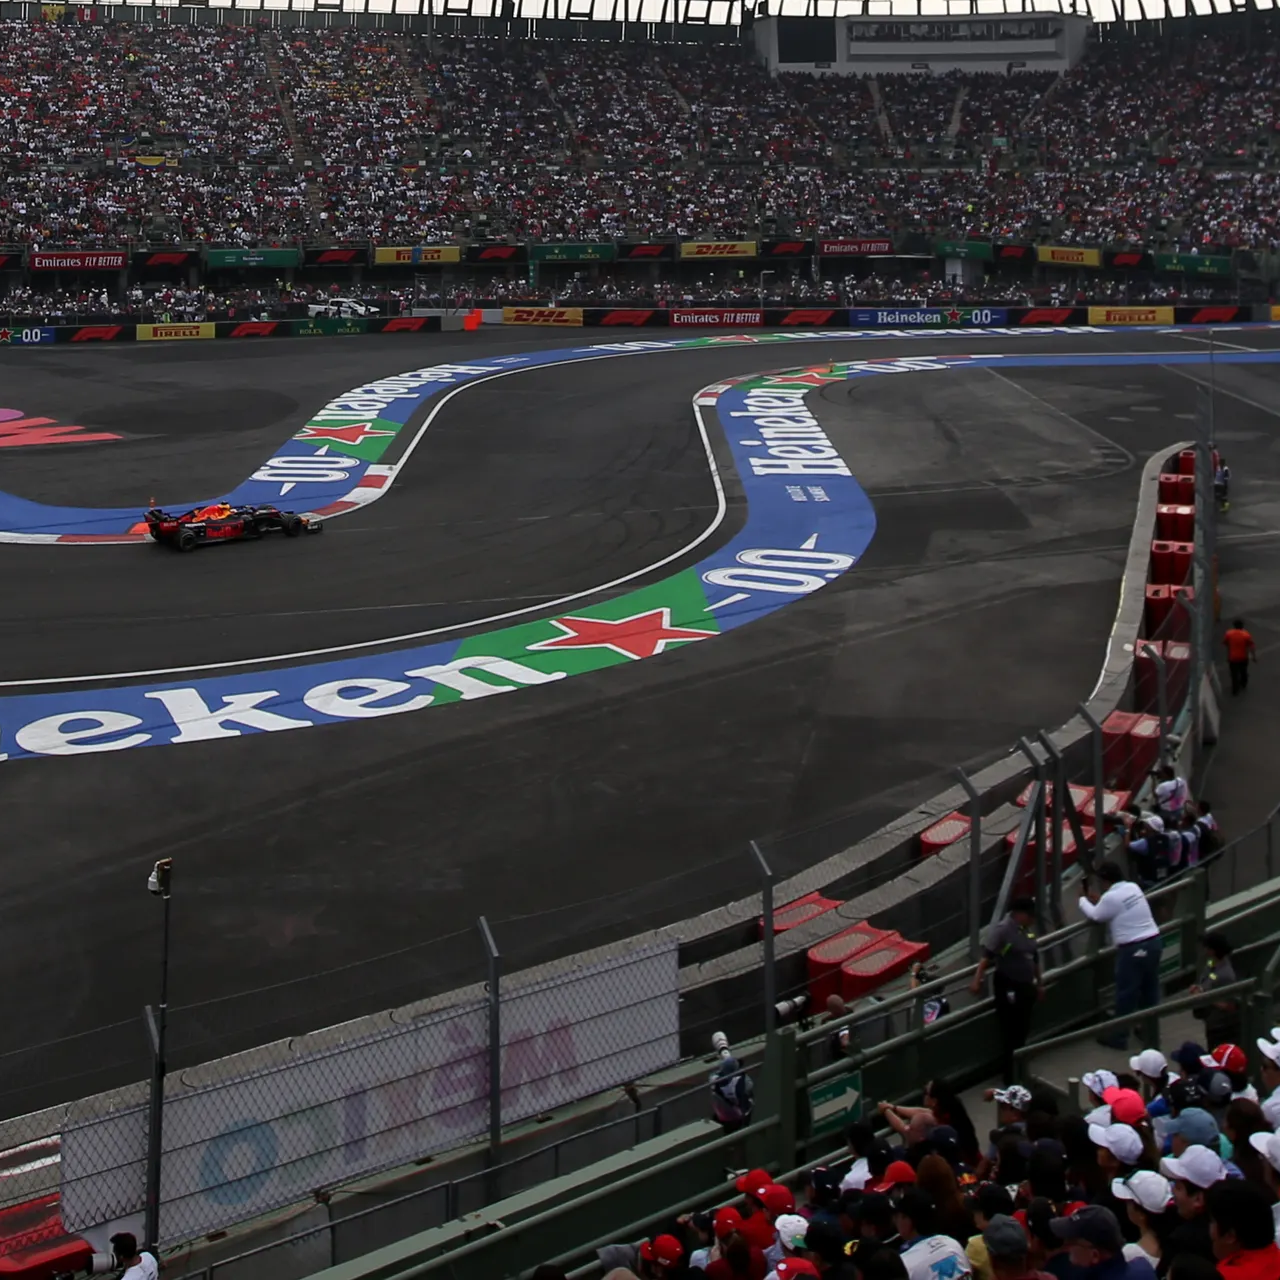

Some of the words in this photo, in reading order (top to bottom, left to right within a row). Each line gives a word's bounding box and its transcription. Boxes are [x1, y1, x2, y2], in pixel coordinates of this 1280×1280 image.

[695, 244, 739, 255] DHL
[823, 243, 859, 253] Emirates
[860, 243, 871, 252] FLY
[871, 242, 890, 252] BETTER
[34, 256, 82, 268] Emirates
[84, 257, 100, 267] FLY
[100, 255, 124, 266] BETTER
[512, 310, 569, 323] DHL
[673, 312, 720, 324] Emirates
[723, 313, 734, 324] FLY
[735, 312, 761, 324] BETTER
[877, 312, 941, 324] Heineken
[1105, 310, 1157, 323] PIRELLI
[152, 326, 200, 338] PIRELLI
[312, 363, 503, 422] Heineken
[730, 388, 853, 477] Heineken
